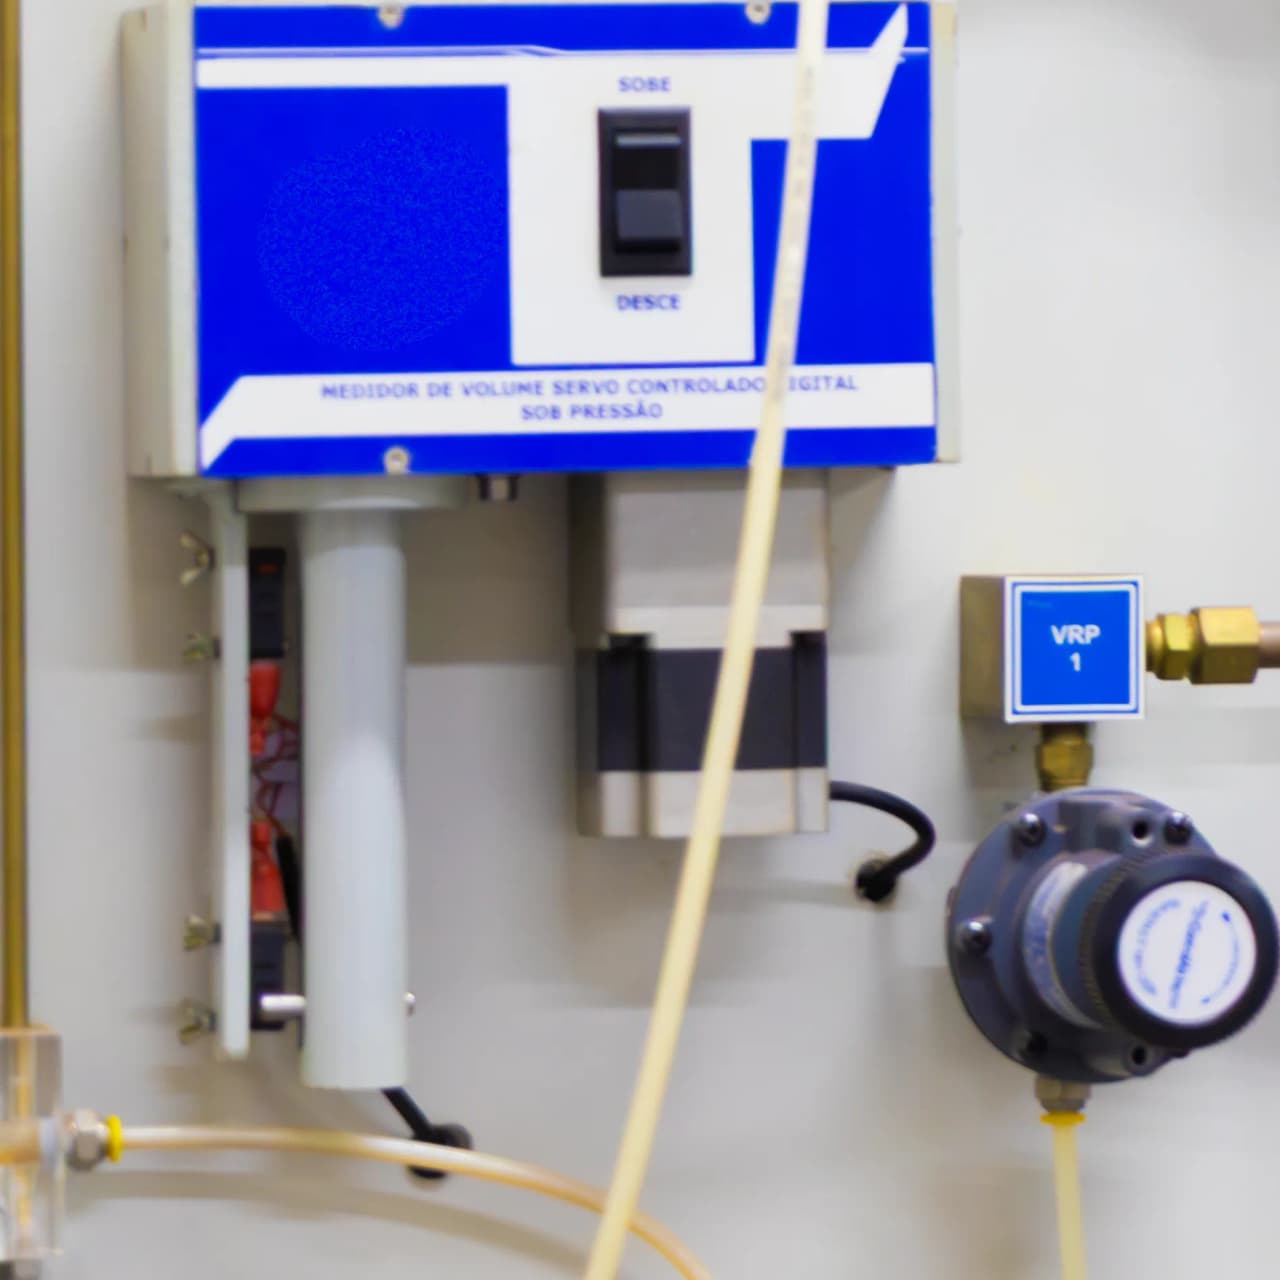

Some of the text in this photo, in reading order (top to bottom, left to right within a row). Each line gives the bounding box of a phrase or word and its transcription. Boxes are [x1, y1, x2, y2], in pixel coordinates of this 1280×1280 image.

[618, 77, 670, 92] SOBE
[616, 294, 681, 311] DESCE
[321, 380, 420, 399] MEDIDOR
[427, 380, 453, 398] DE
[460, 379, 546, 398] VOLUME
[552, 378, 620, 397] SERVO
[787, 374, 858, 393] IGITAL
[521, 399, 664, 421] SOB PRESSÃO
[1050, 624, 1101, 645] VRP
[1069, 651, 1082, 672] 1
